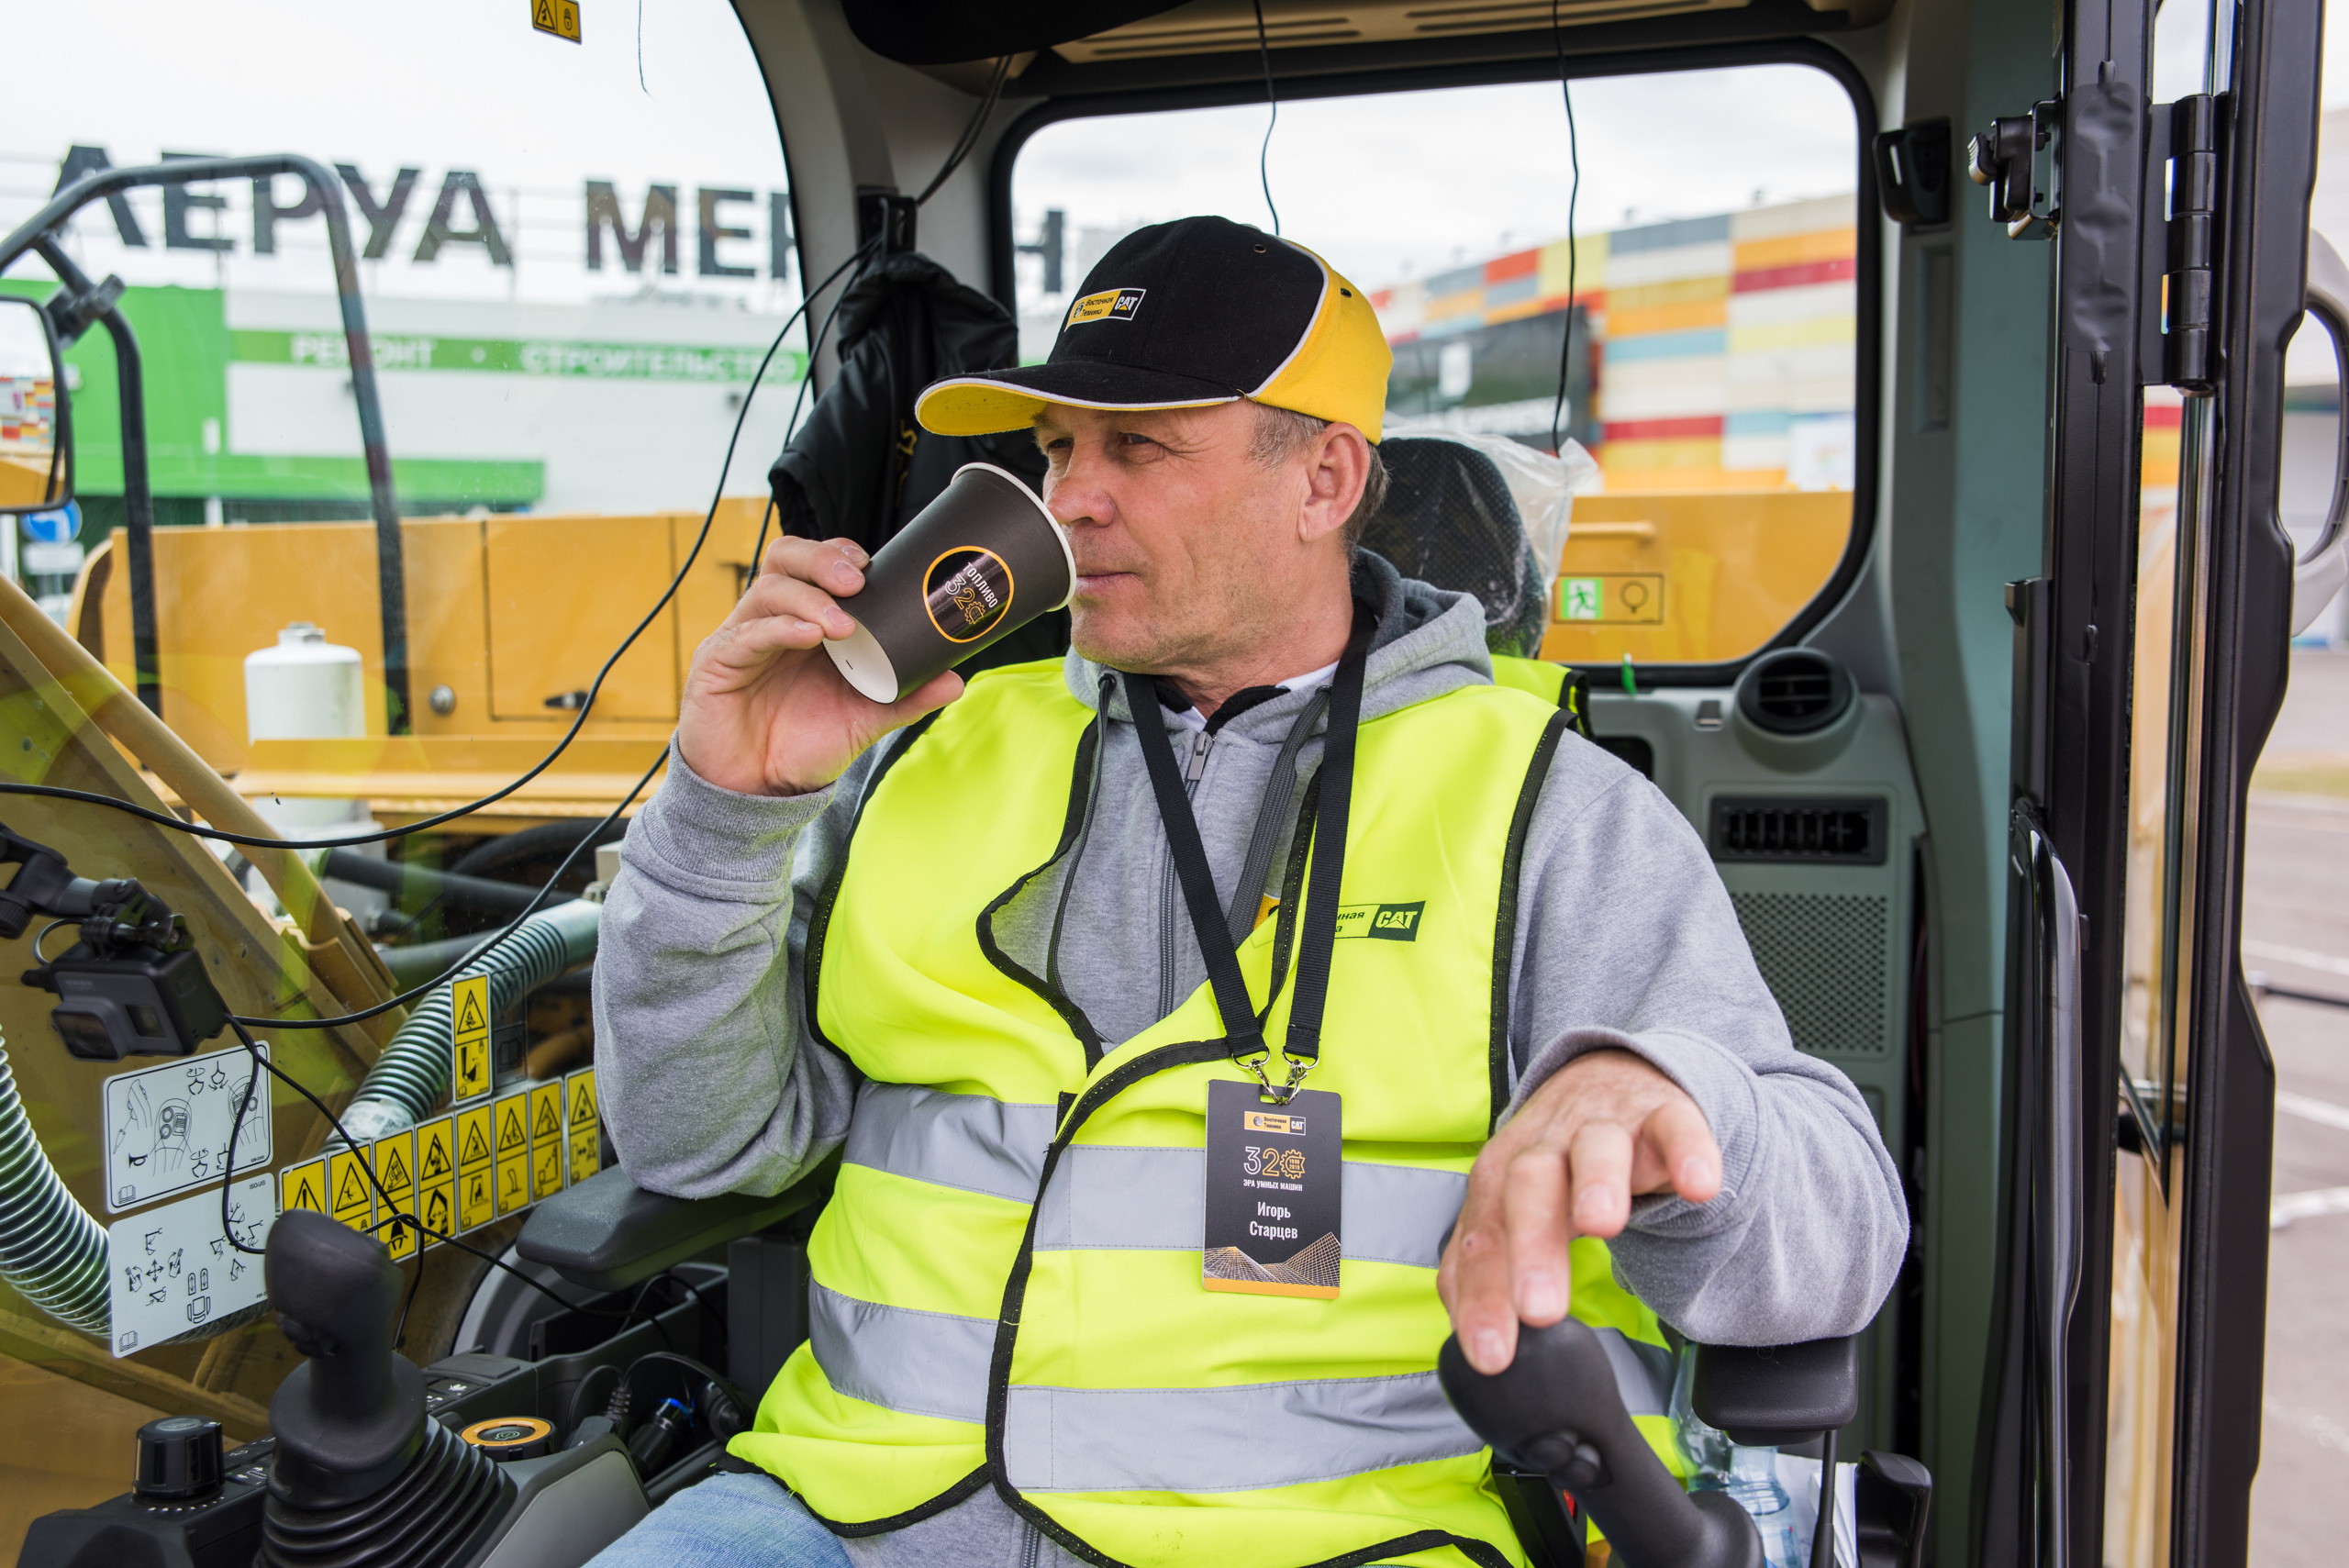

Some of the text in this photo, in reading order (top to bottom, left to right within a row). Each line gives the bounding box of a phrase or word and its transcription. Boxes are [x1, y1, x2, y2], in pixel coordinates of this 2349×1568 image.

[51, 144, 514, 267] ЛЕРУА
[1085, 296, 1114, 306] Восточная
[1114, 295, 1139, 311] CAT
[1081, 308, 1103, 317] Техника
[963, 562, 998, 608] ТОПЛИВО
[1375, 910, 1419, 929] CAT
[1264, 1116, 1287, 1124] Восточная
[1290, 1120, 1305, 1130] CAT
[1242, 1179, 1303, 1192] ЭРА УМНЫХ МАШИН
[1257, 1201, 1291, 1221] Игорь
[1249, 1220, 1298, 1240] Старцев
